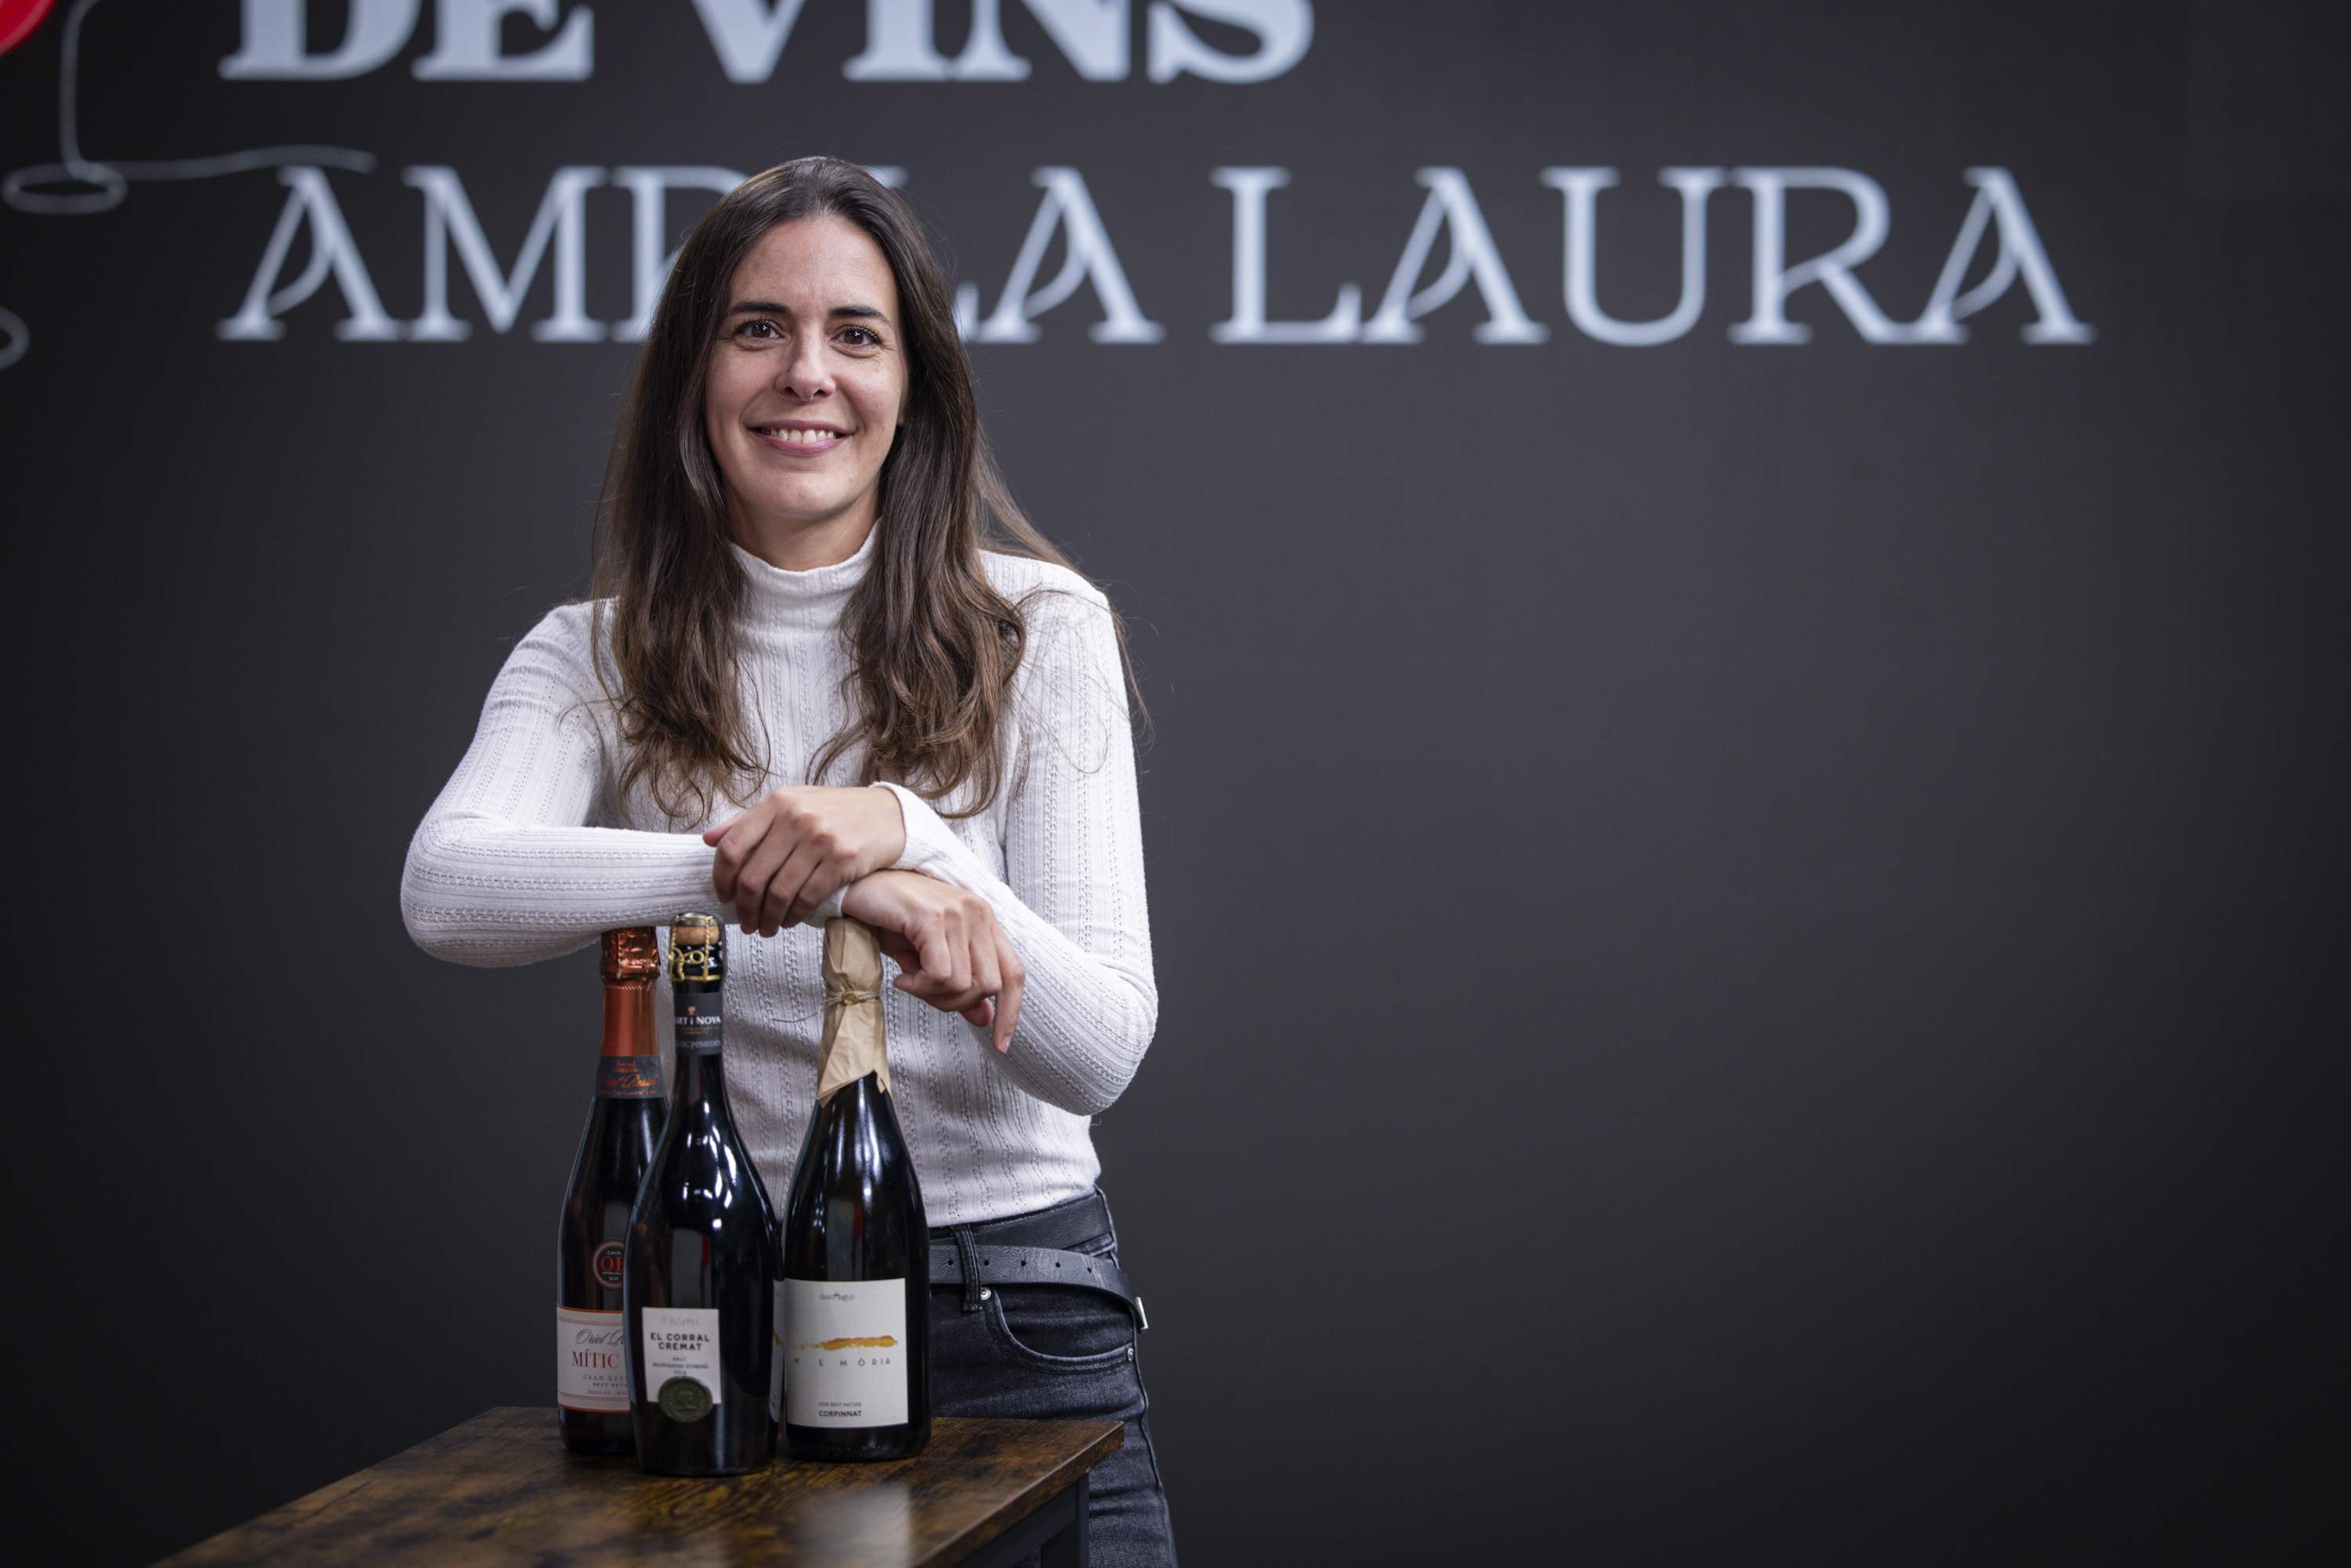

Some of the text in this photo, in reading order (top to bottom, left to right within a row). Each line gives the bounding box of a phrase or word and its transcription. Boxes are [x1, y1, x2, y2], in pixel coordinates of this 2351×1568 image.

[1209, 167, 2096, 346] LAURA
[650, 1332, 711, 1342] EL CORRAL
[658, 1342, 702, 1351] CREMAT
[572, 1349, 620, 1369] MÍTIC
